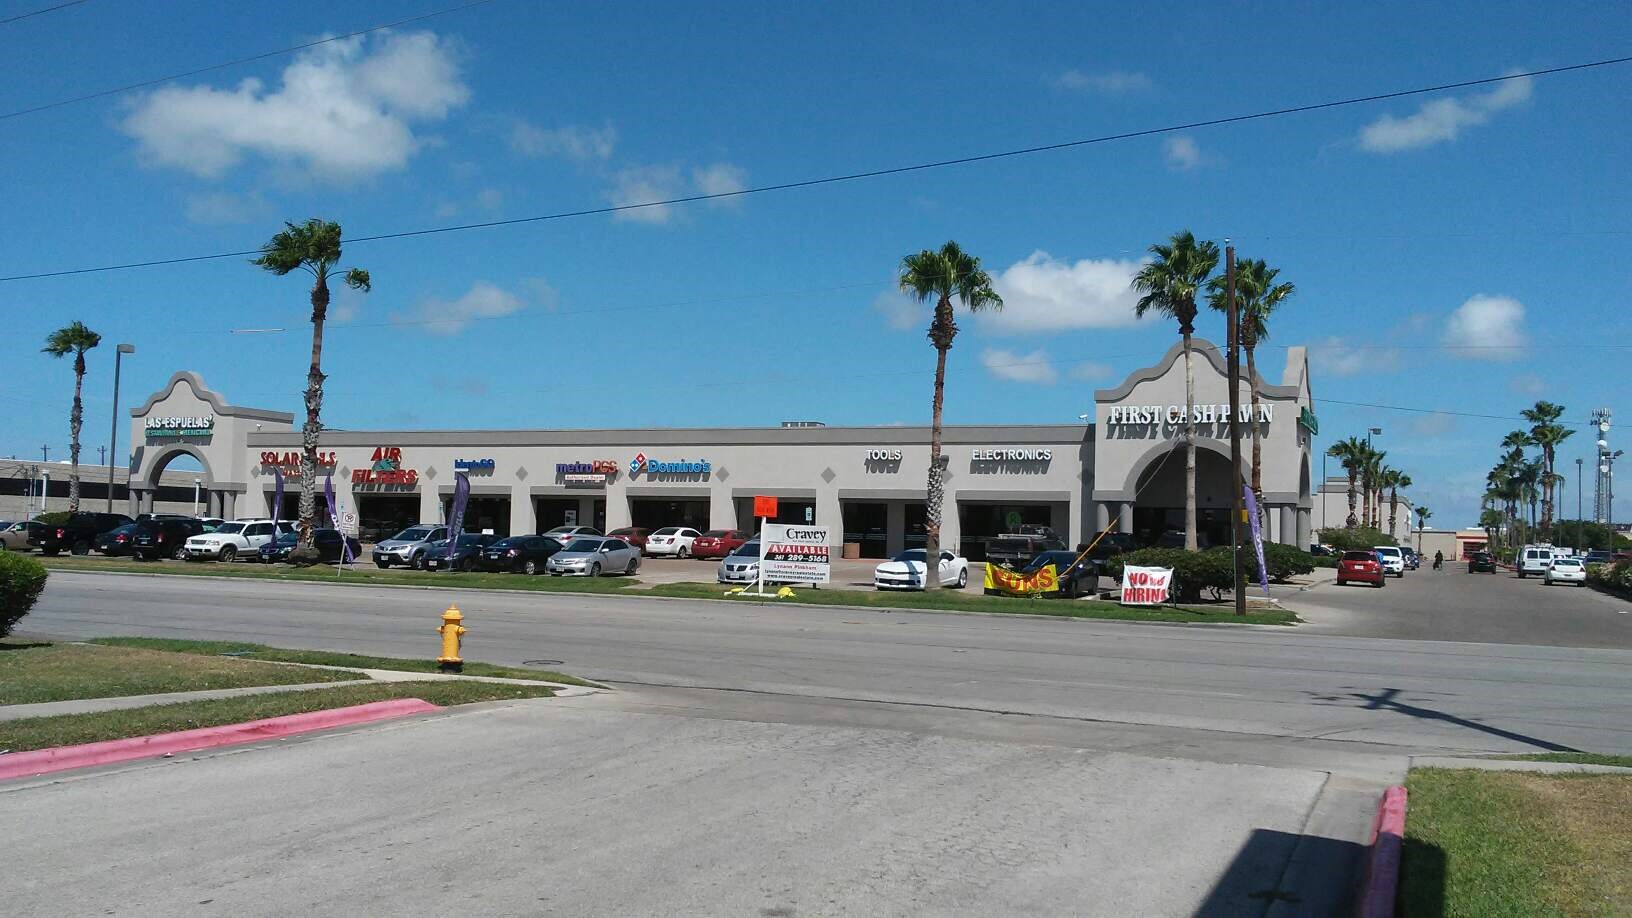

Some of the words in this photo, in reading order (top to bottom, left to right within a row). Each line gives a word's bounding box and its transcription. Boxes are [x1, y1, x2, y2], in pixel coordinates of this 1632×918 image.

[1109, 405, 1162, 424] FIRST
[1165, 404, 1217, 424] CASH
[144, 417, 161, 428] LAS
[165, 416, 209, 428] ESPUELAS
[260, 451, 301, 466] SOLAR
[371, 447, 401, 462] AIR
[866, 449, 902, 460] TOOLS
[972, 449, 1052, 460] ELECTRONICS
[555, 460, 617, 473] metroPCS
[648, 459, 711, 473] Domino's
[352, 469, 417, 483] FILTERS
[786, 528, 826, 543] Cravey
[772, 545, 827, 554] AVAILABLE
